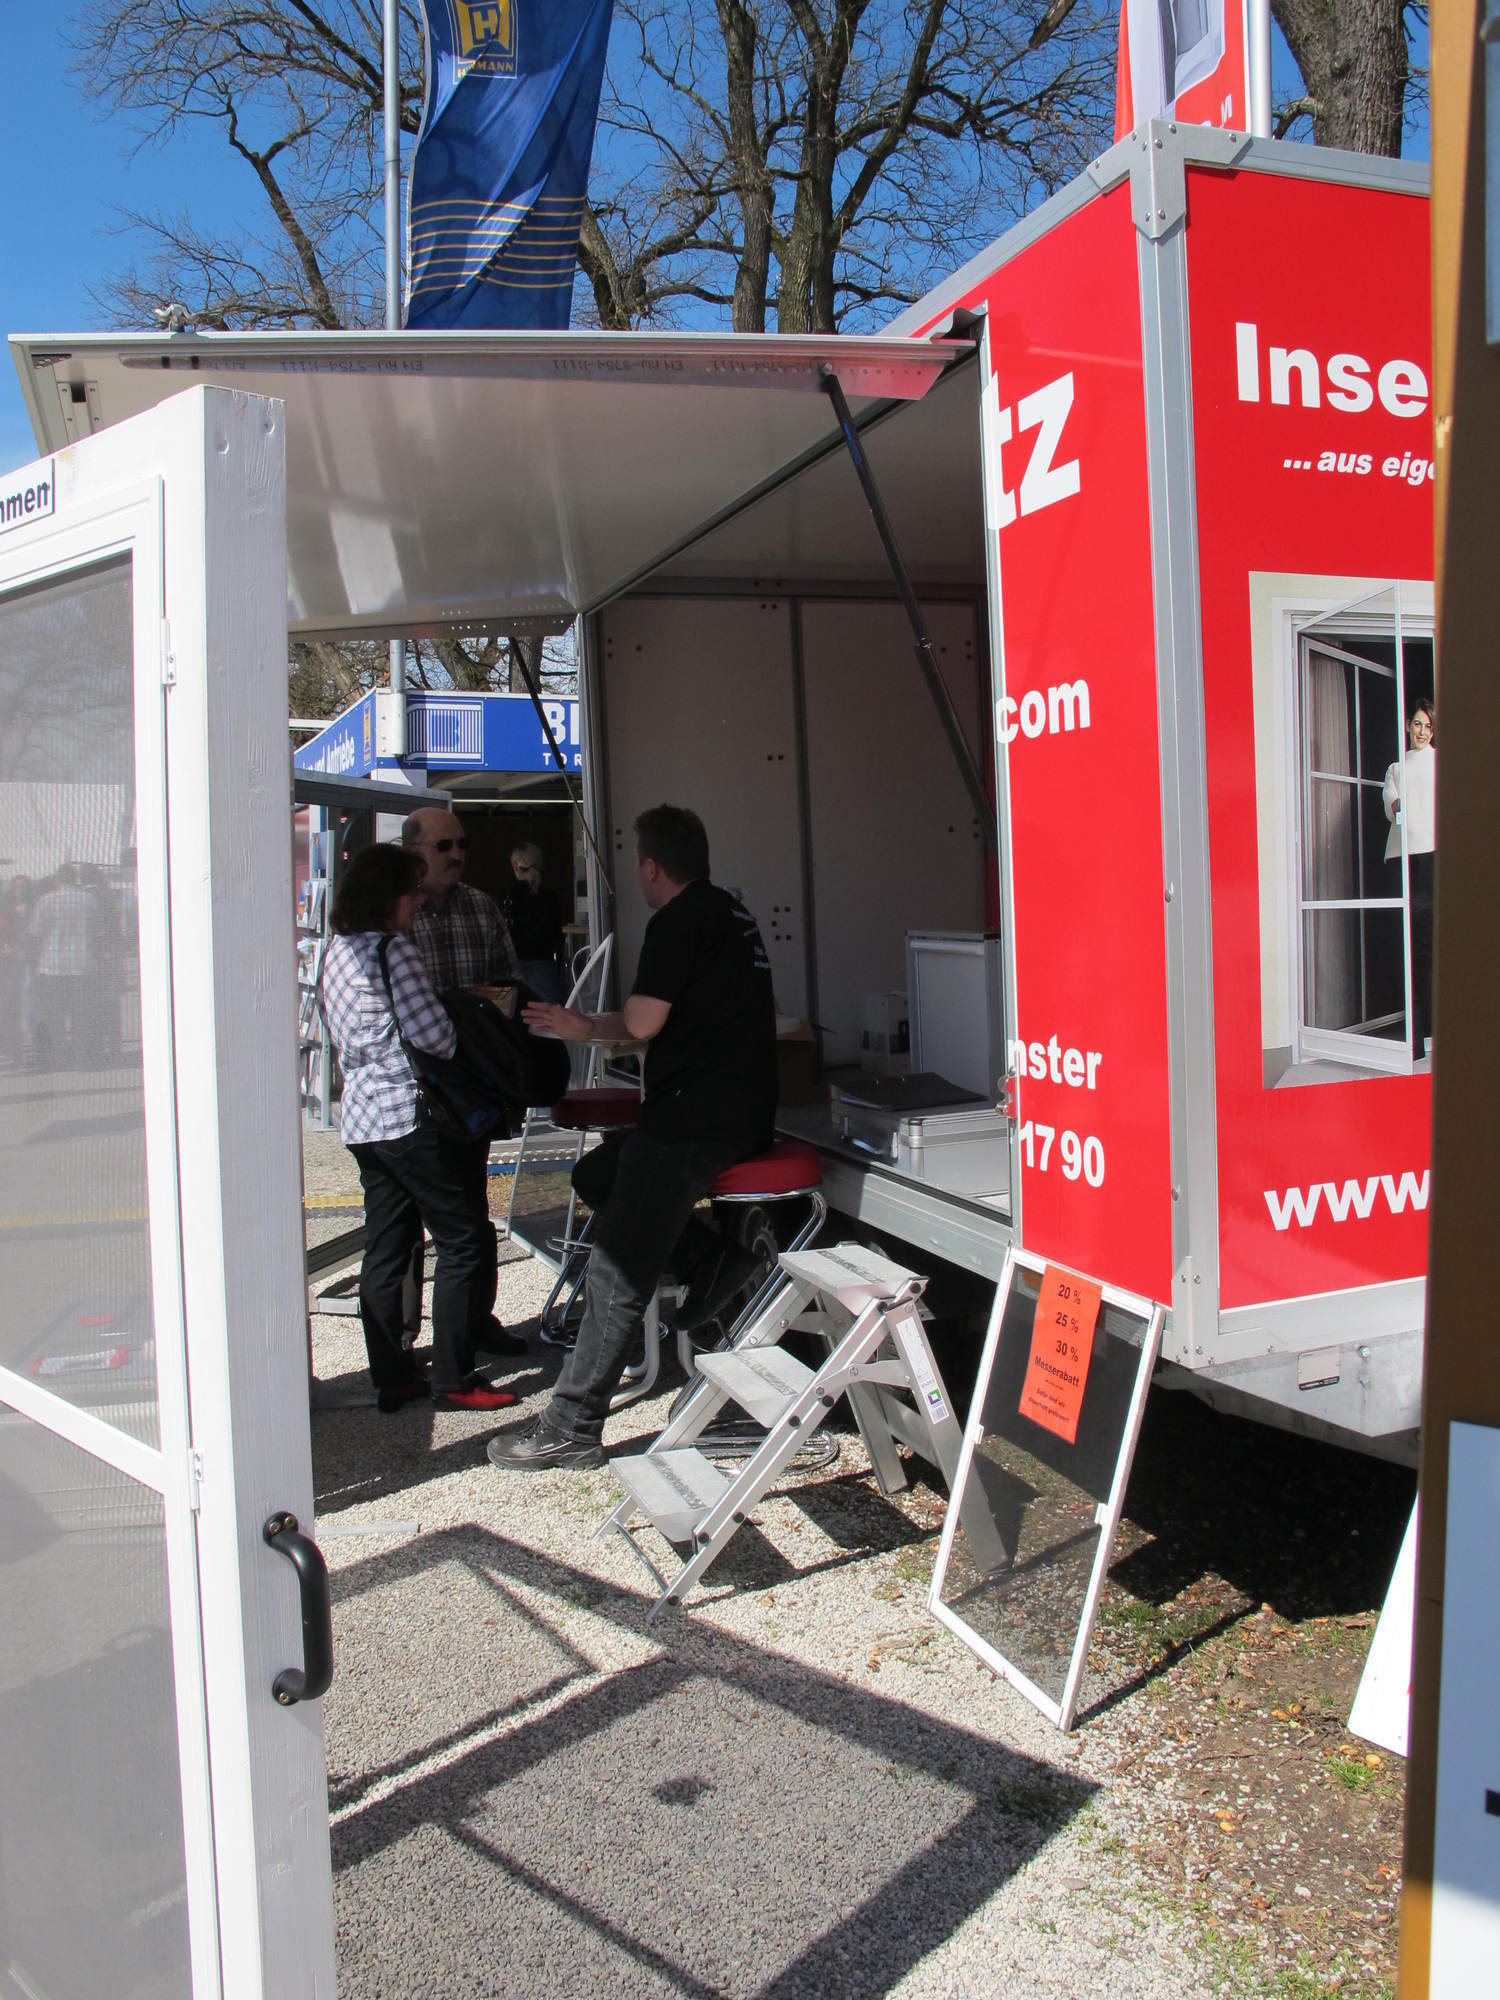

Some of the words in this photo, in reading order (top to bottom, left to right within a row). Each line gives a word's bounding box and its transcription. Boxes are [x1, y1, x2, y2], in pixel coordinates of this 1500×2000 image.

[457, 60, 513, 78] HMANN
[1317, 451, 1372, 475] aus
[1058, 1284, 1070, 1300] 20
[1073, 1289, 1081, 1305] %
[1055, 1312, 1068, 1327] 25
[1071, 1317, 1079, 1333] %
[1055, 1340, 1068, 1355] 30
[1070, 1346, 1078, 1362] %
[1034, 1355, 1080, 1387] Messerabatt
